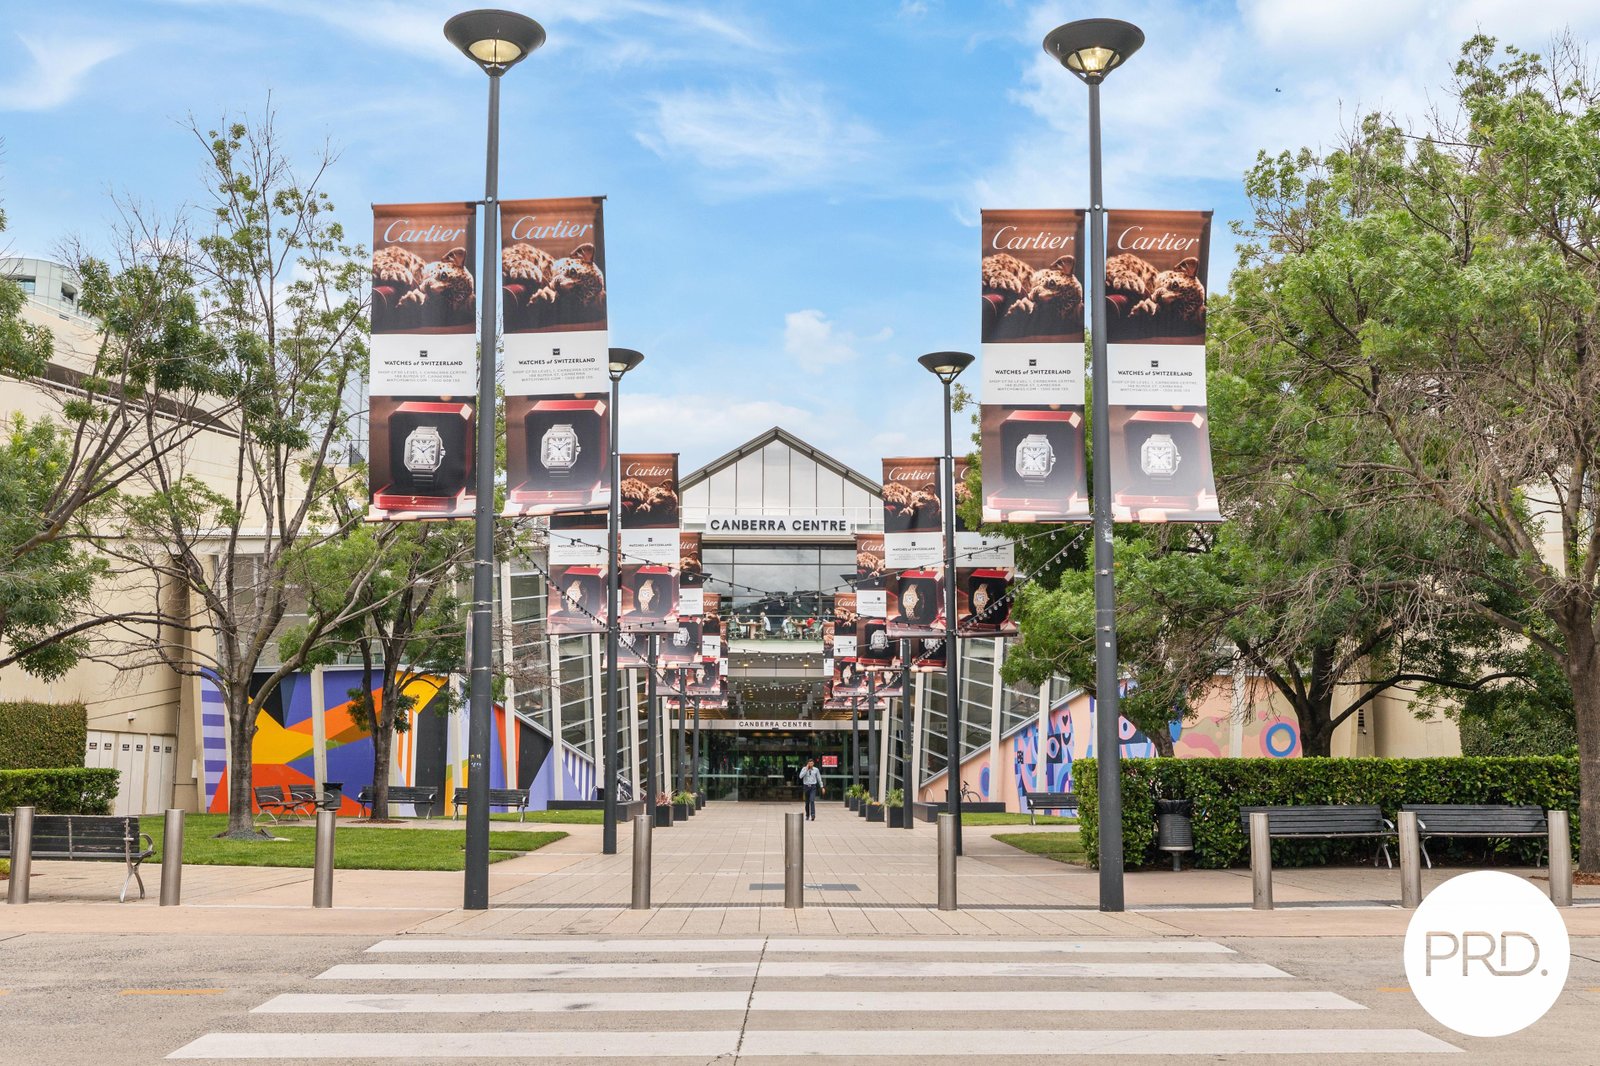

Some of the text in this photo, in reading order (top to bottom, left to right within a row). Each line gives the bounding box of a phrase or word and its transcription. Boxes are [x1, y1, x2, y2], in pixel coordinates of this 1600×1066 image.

[384, 219, 466, 243] Cartier
[511, 215, 593, 240] Cartier
[992, 225, 1075, 250] Cartier
[1117, 225, 1200, 251] Cartier
[625, 462, 673, 477] Cartier
[888, 466, 935, 481] Cartier
[710, 519, 847, 531] CANBERRA CENTRE
[680, 541, 698, 550] tier
